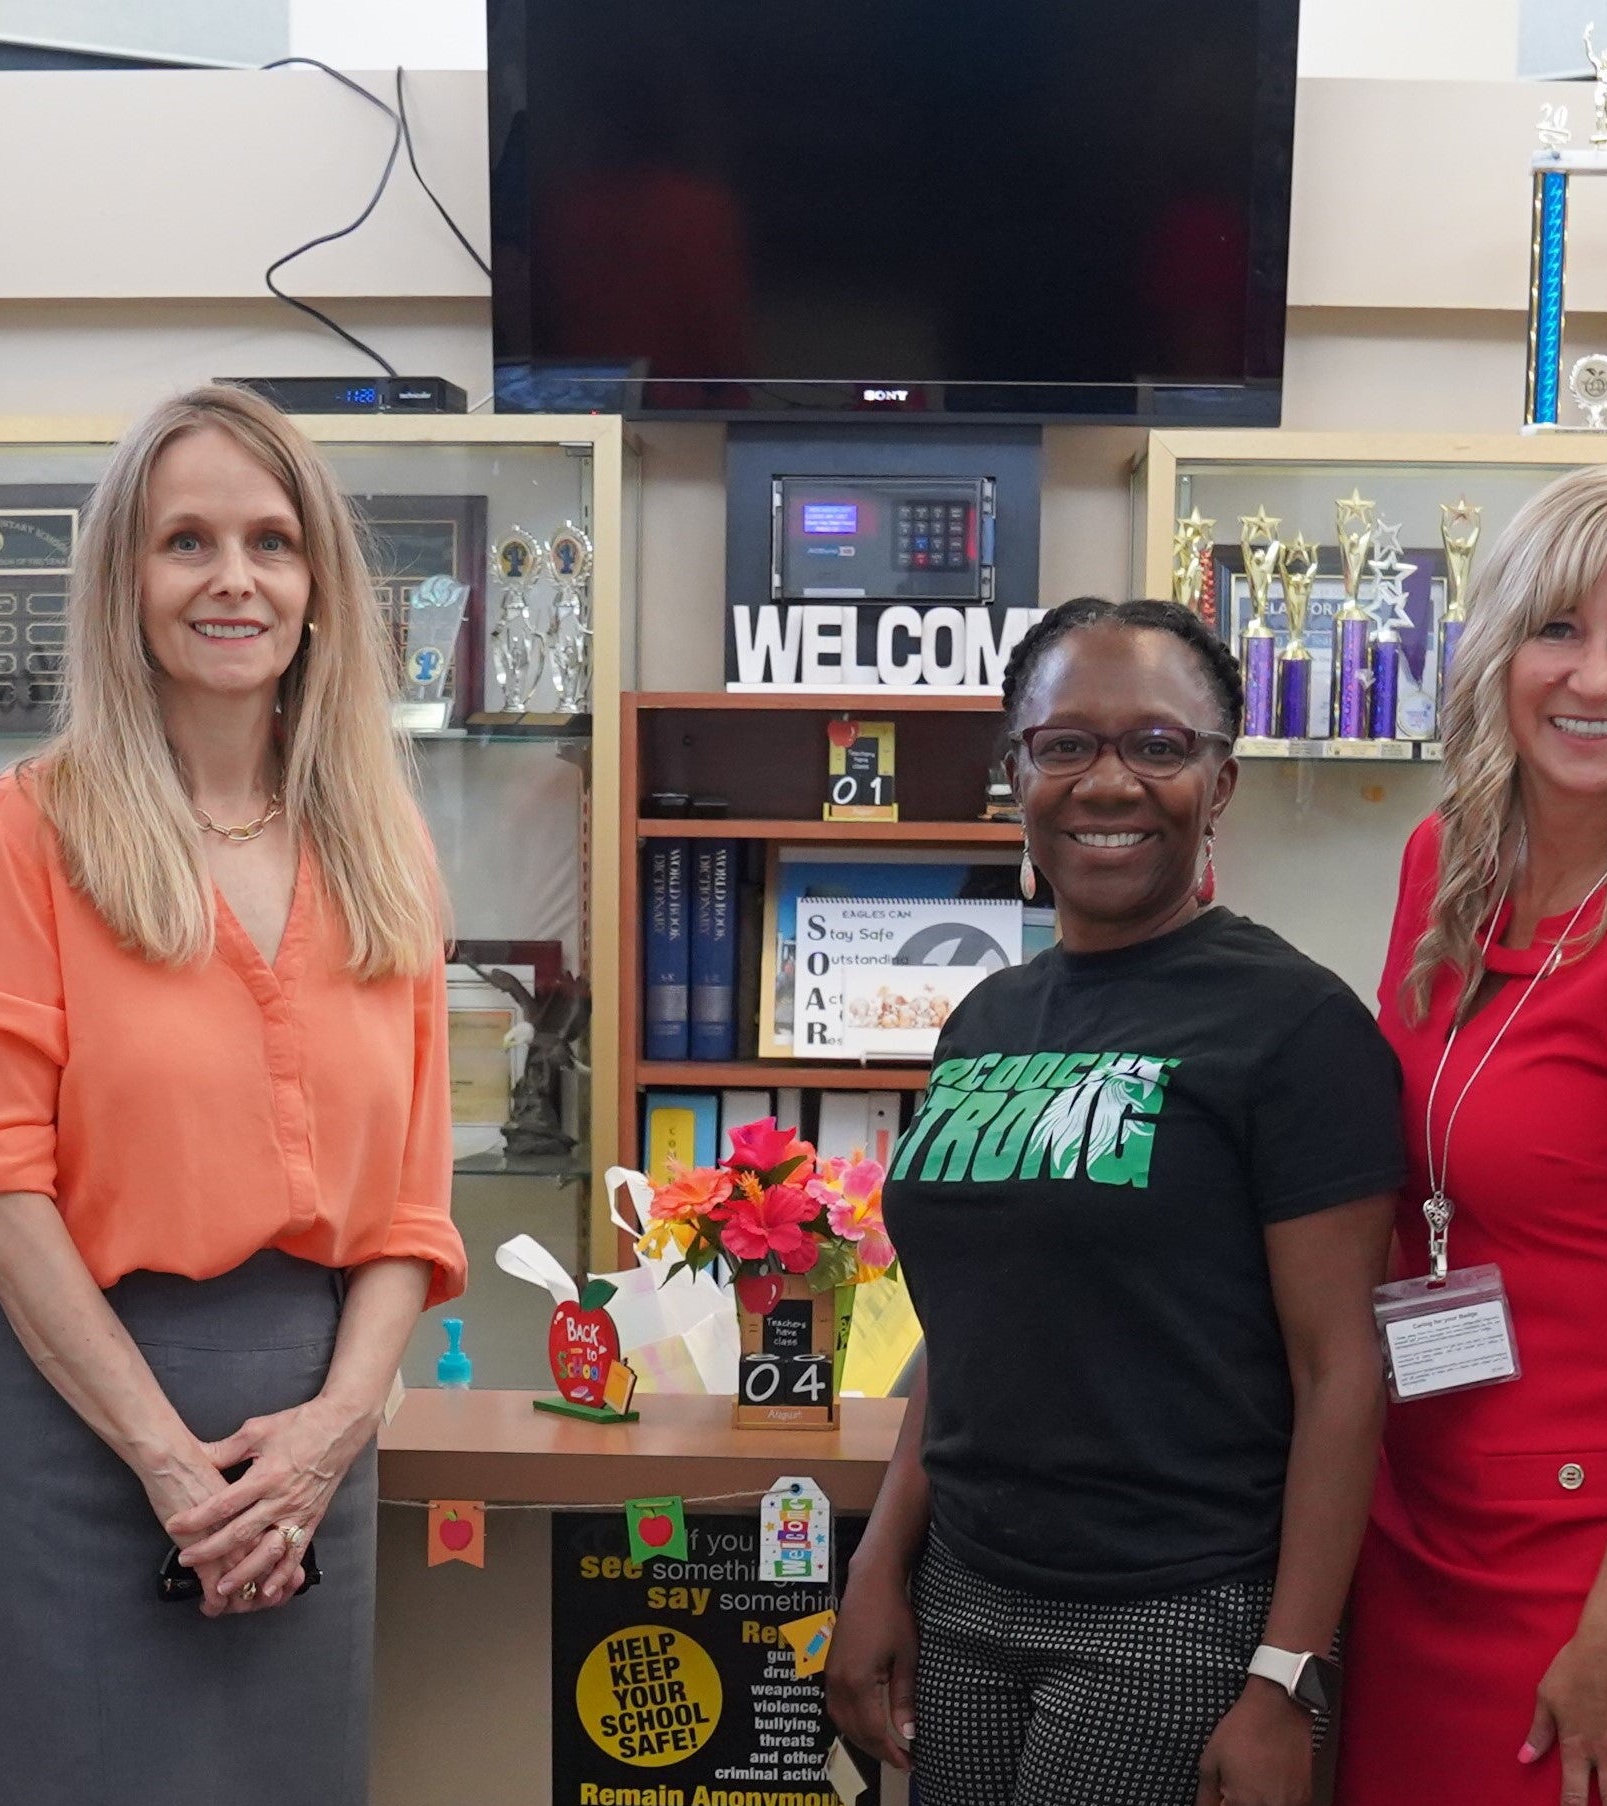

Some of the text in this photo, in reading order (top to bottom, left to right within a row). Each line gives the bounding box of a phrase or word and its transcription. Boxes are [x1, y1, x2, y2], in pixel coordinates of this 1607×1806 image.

[864, 390, 909, 401] SONY
[733, 605, 1050, 684] WELCOM
[842, 911, 912, 919] EAGLES CAN
[859, 928, 894, 941] Safe
[767, 1318, 807, 1329] Teachers
[776, 1328, 797, 1336] have
[773, 1336, 797, 1347] class
[587, 1348, 598, 1362] to
[707, 1534, 754, 1556] you
[580, 1555, 643, 1579] see
[647, 1586, 711, 1615] say
[606, 1633, 676, 1663] HELP
[610, 1656, 681, 1687] KEEP
[612, 1680, 687, 1712] YOUR
[750, 1684, 825, 1699] weapons,
[753, 1700, 823, 1716] violence,
[600, 1702, 710, 1737] SCHOOL
[754, 1717, 821, 1733] bullying,
[618, 1727, 698, 1760] SAFE!
[760, 1734, 815, 1747] threats
[750, 1751, 824, 1764] and other
[715, 1767, 777, 1780] criminal
[580, 1783, 684, 1806] Remain
